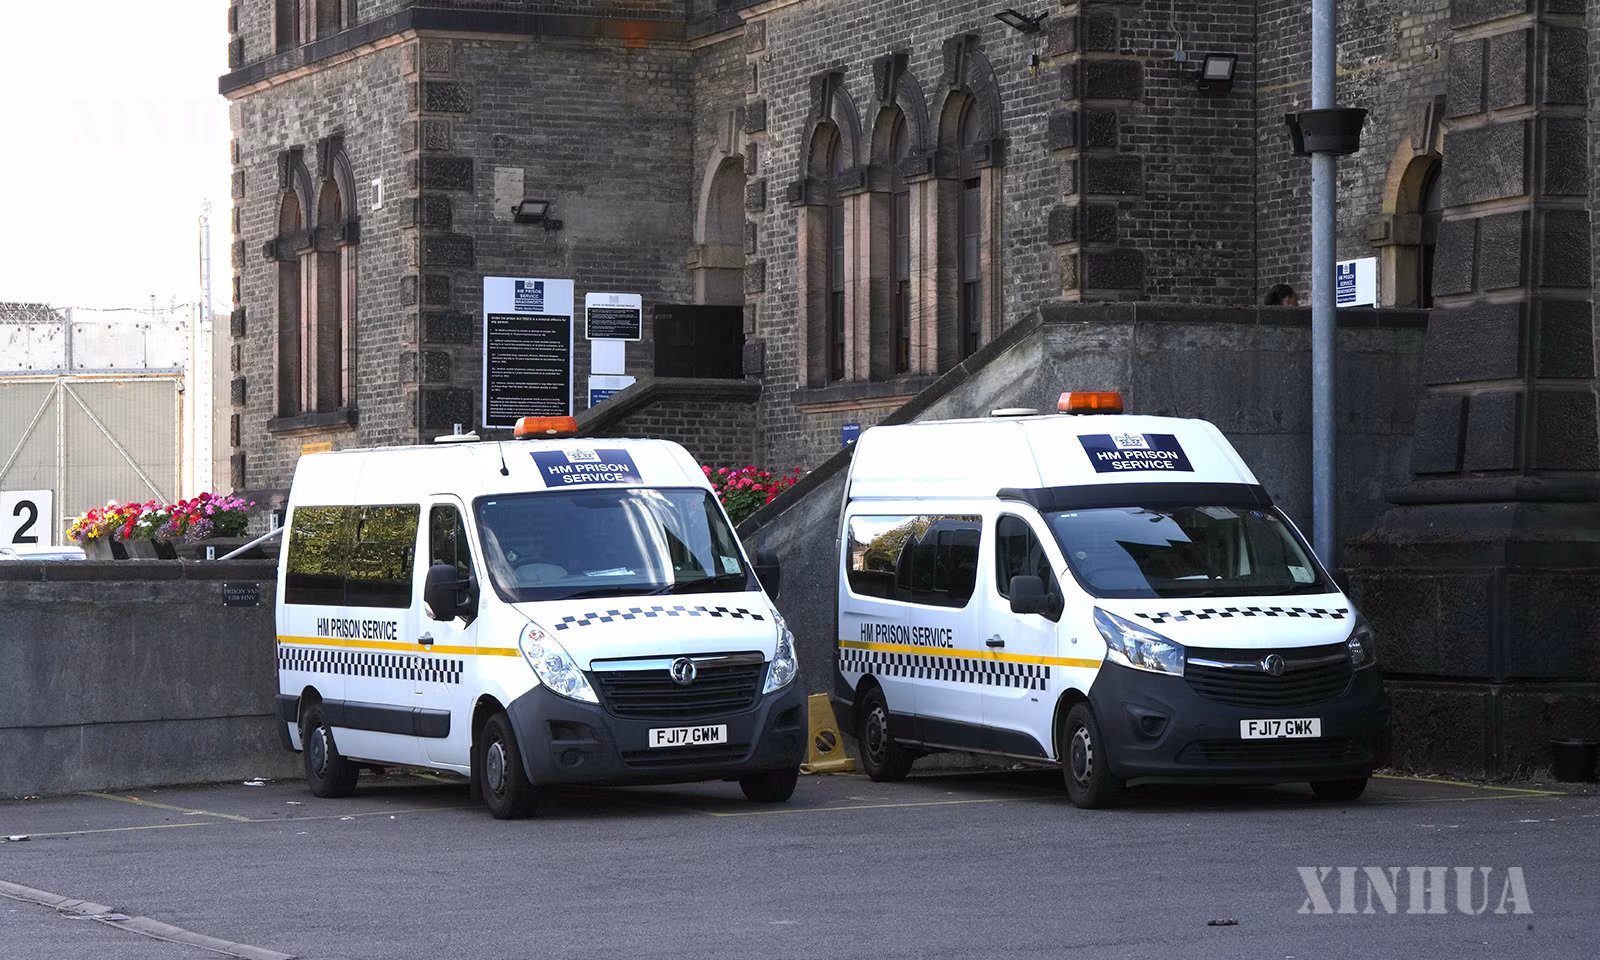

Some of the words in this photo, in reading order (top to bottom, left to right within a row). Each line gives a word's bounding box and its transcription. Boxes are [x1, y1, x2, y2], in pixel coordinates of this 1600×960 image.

[1096, 452, 1122, 460] HM
[1124, 450, 1178, 460] PRISON
[548, 464, 572, 474] HM
[574, 463, 630, 472] PRISON
[1112, 460, 1174, 470] SERVICE
[562, 472, 624, 483] SERVICE
[12, 500, 38, 544] 2
[317, 618, 329, 636] HM
[331, 618, 360, 638] PRISON
[362, 620, 398, 640] SERVICE
[860, 623, 874, 642] HM
[876, 624, 910, 645] PRISON
[912, 626, 953, 648] SERVICE
[657, 728, 688, 744] FJ17
[692, 727, 719, 742] GWM
[1249, 721, 1281, 736] FJ17
[1285, 720, 1312, 735] GWK
